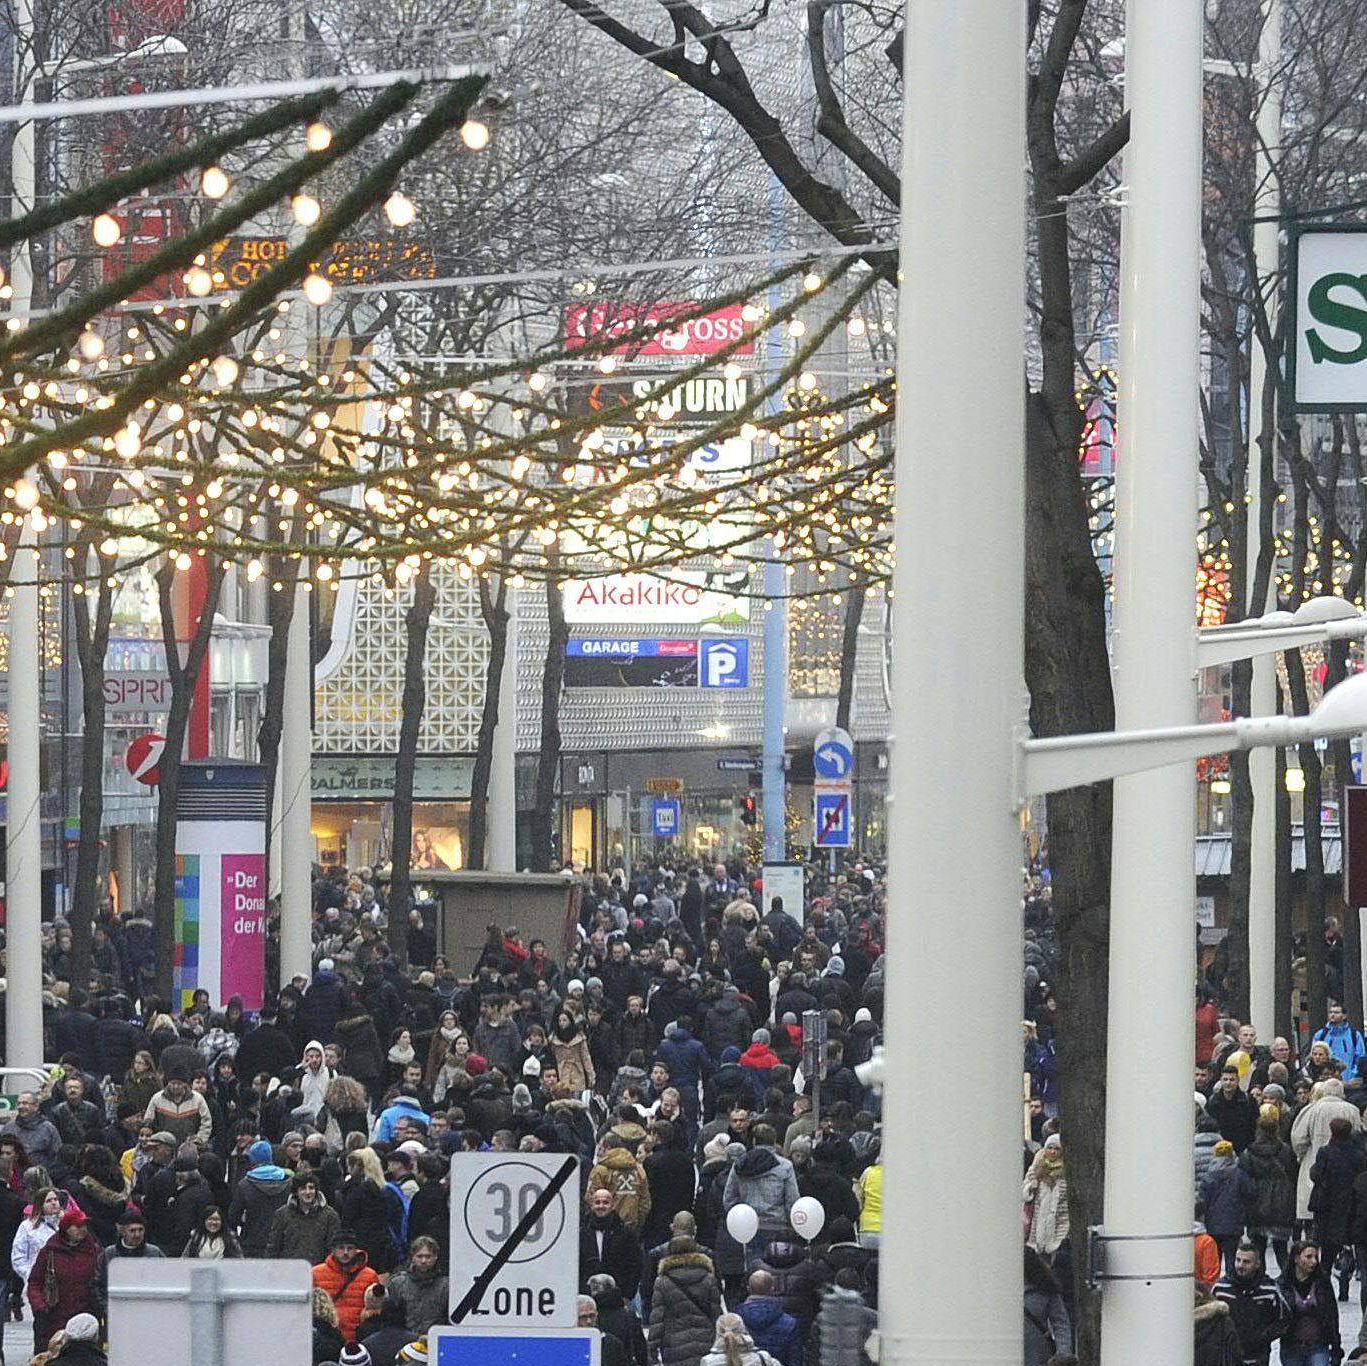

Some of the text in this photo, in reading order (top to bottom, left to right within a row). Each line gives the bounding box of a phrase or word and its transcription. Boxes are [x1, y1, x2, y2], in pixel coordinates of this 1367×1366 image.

[576, 578, 702, 606] Akakiko
[582, 641, 640, 654] GARAGE
[102, 678, 172, 705] SPRI
[234, 916, 256, 934] der
[485, 1181, 545, 1244] 30
